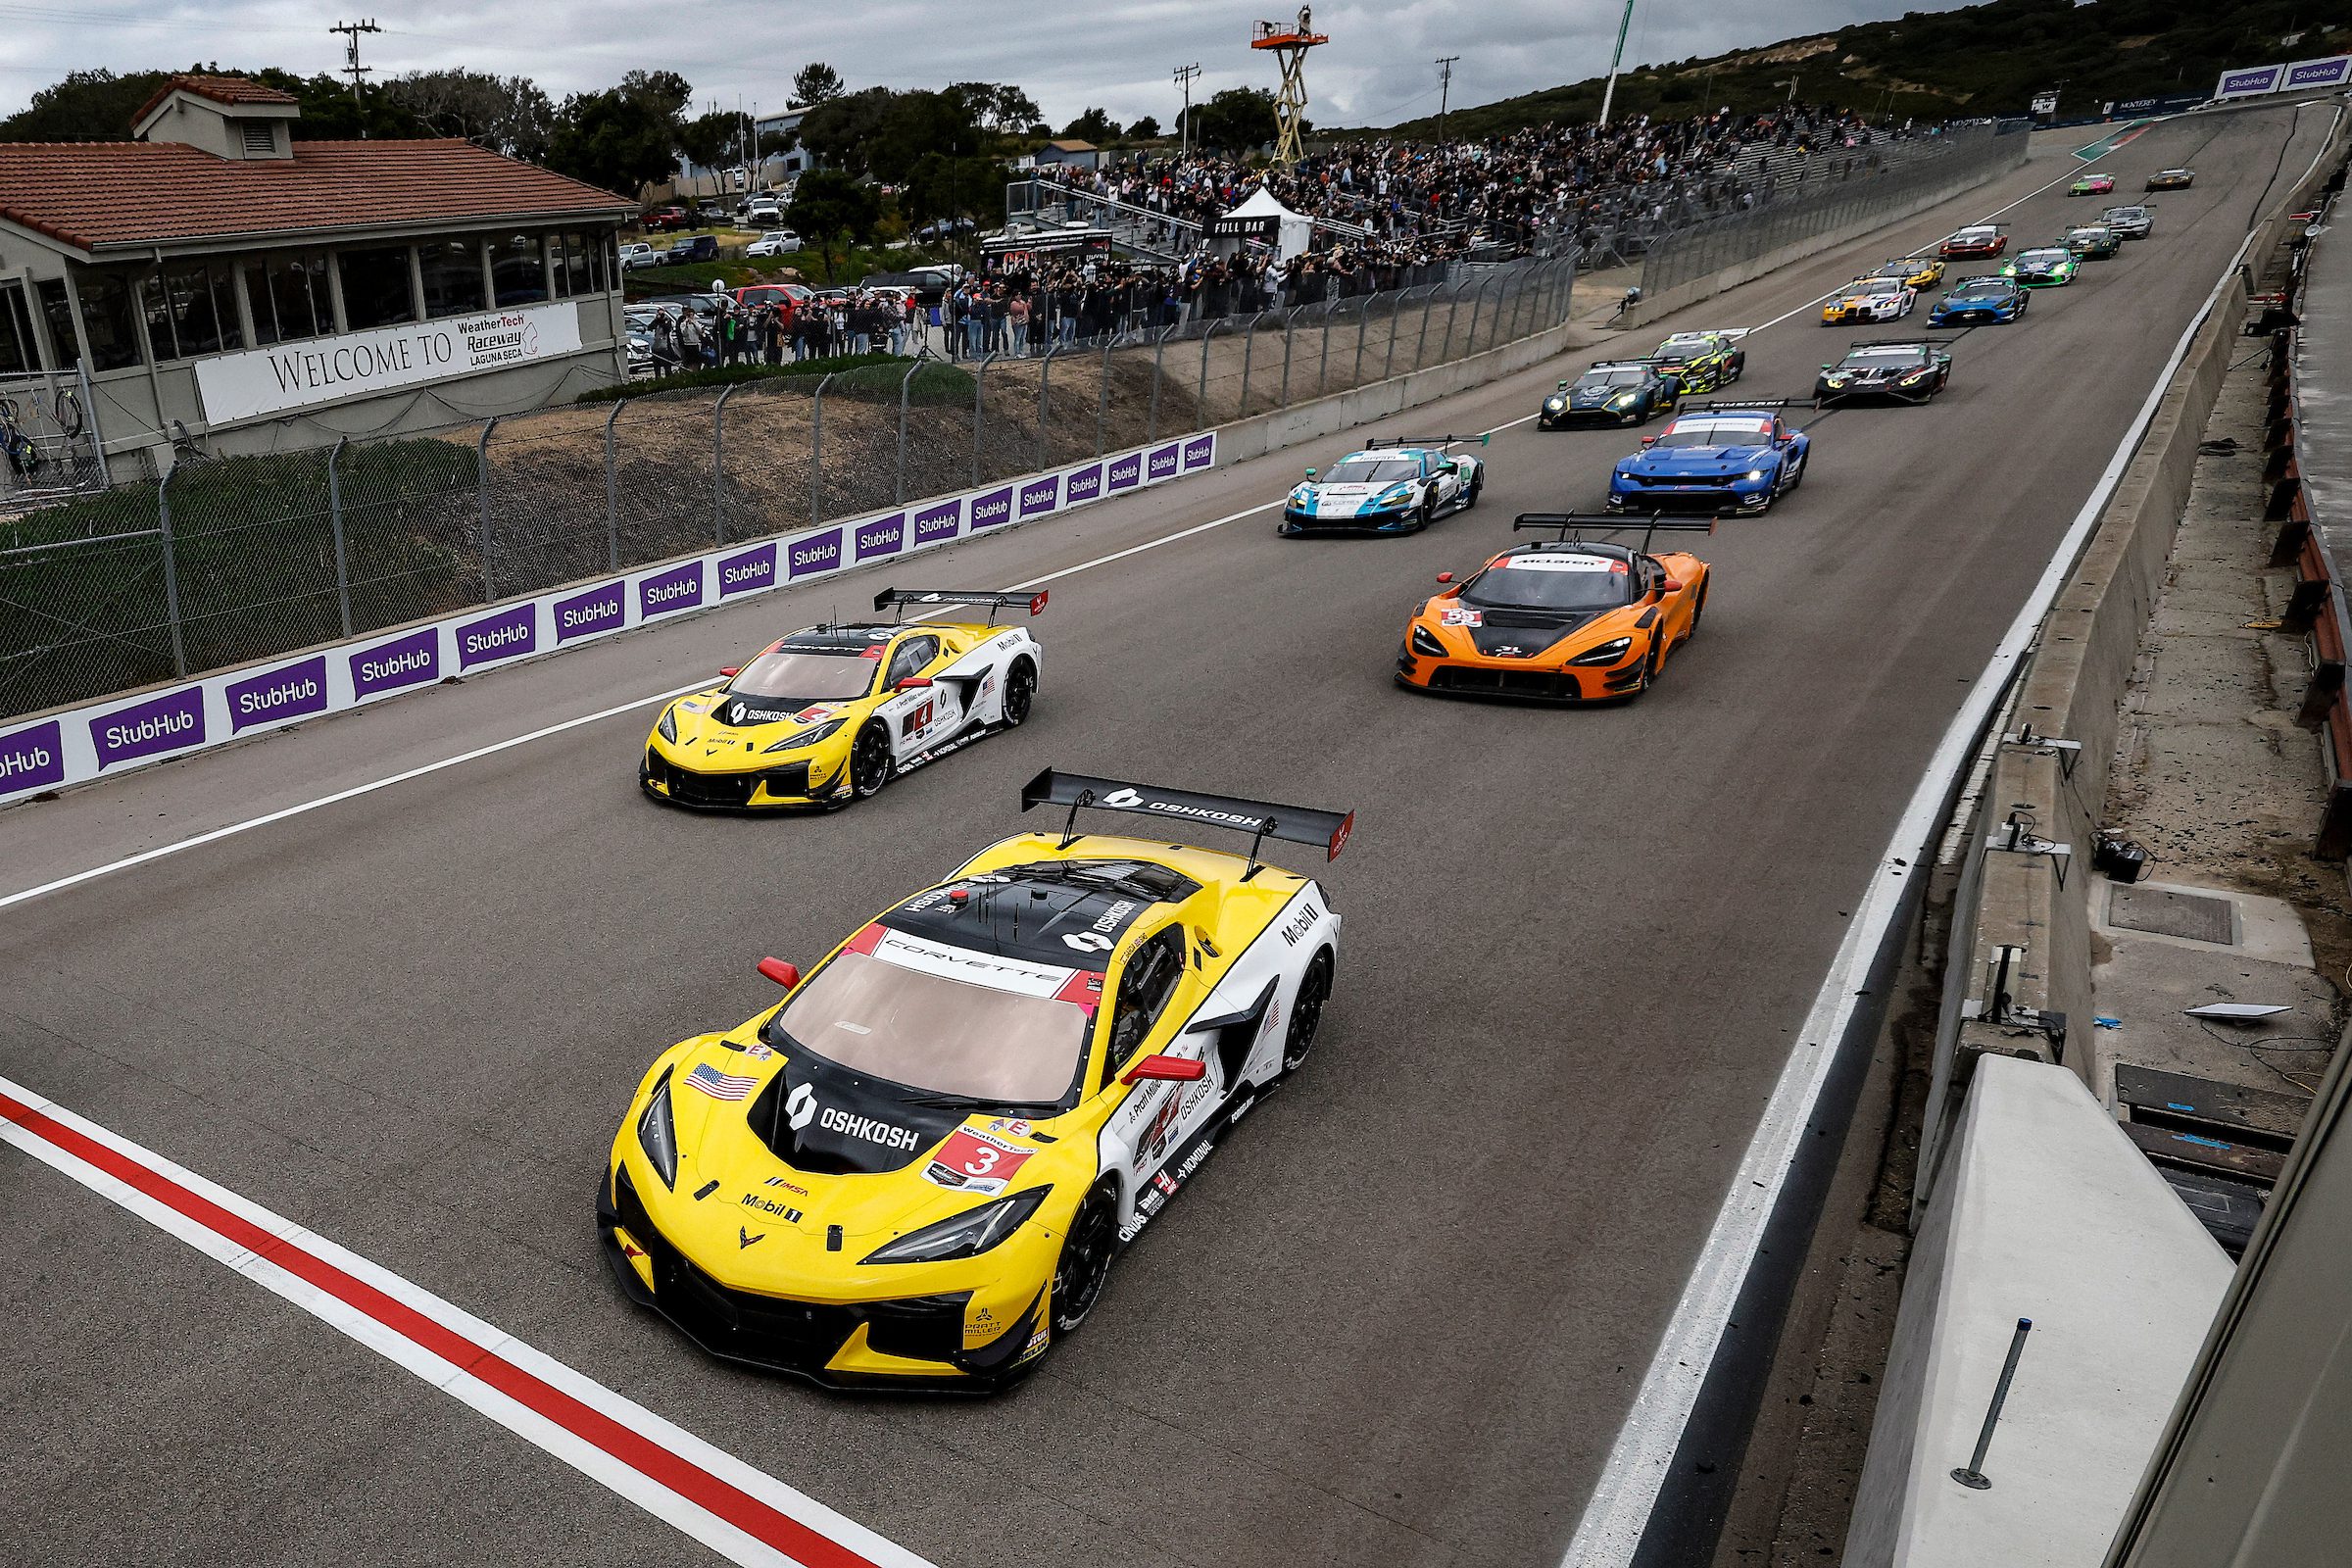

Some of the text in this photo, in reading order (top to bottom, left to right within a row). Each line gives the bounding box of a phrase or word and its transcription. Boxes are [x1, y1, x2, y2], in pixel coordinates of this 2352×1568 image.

[2229, 77, 2269, 88] StubHub
[2295, 68, 2338, 79] StubHub
[1215, 221, 1265, 233] FULL BAR
[458, 314, 525, 334] WeatherTech
[467, 331, 521, 353] Raceway
[268, 332, 453, 393] WELCOME TO
[470, 348, 523, 367] LAGUNA SECA
[1151, 456, 1176, 472] StubHub
[1187, 444, 1210, 462] StubHub
[1111, 466, 1138, 482] StubHub
[1070, 476, 1099, 495] StubHub
[1023, 488, 1054, 507] StubHub
[975, 501, 1007, 520] StubHub
[919, 514, 956, 535] StubHub
[860, 530, 900, 551] StubHub
[794, 544, 837, 567] StubHub
[1515, 559, 1595, 567] McLaren
[724, 562, 771, 585] StubHub
[647, 578, 698, 605] StubHub
[564, 599, 618, 629] StubHub
[466, 622, 528, 654] StubHub
[997, 635, 1017, 652] Mobil
[361, 649, 431, 683] StubHub
[239, 677, 318, 714] StubHub
[747, 710, 795, 721] OSHKOSH
[919, 705, 929, 724] 4
[933, 709, 956, 727] OSHKOSH
[105, 710, 194, 750] StubHub
[1148, 802, 1262, 827] OSHKOSH
[1092, 900, 1137, 933] OSHKOSH
[1281, 910, 1314, 948] Mobil
[885, 939, 1062, 982] CORVETTE
[1134, 1095, 1151, 1119] Pratt
[1180, 1072, 1215, 1121] OSHKOSH
[819, 1106, 920, 1152] OSHKOSH
[963, 1126, 1037, 1153] WeatherTech
[964, 1147, 1001, 1176] 3
[1182, 1140, 1213, 1174] NOMINAL
[781, 1182, 809, 1198] IMSA
[741, 1193, 786, 1217] Mobil
[965, 1321, 1001, 1330] PRATT
